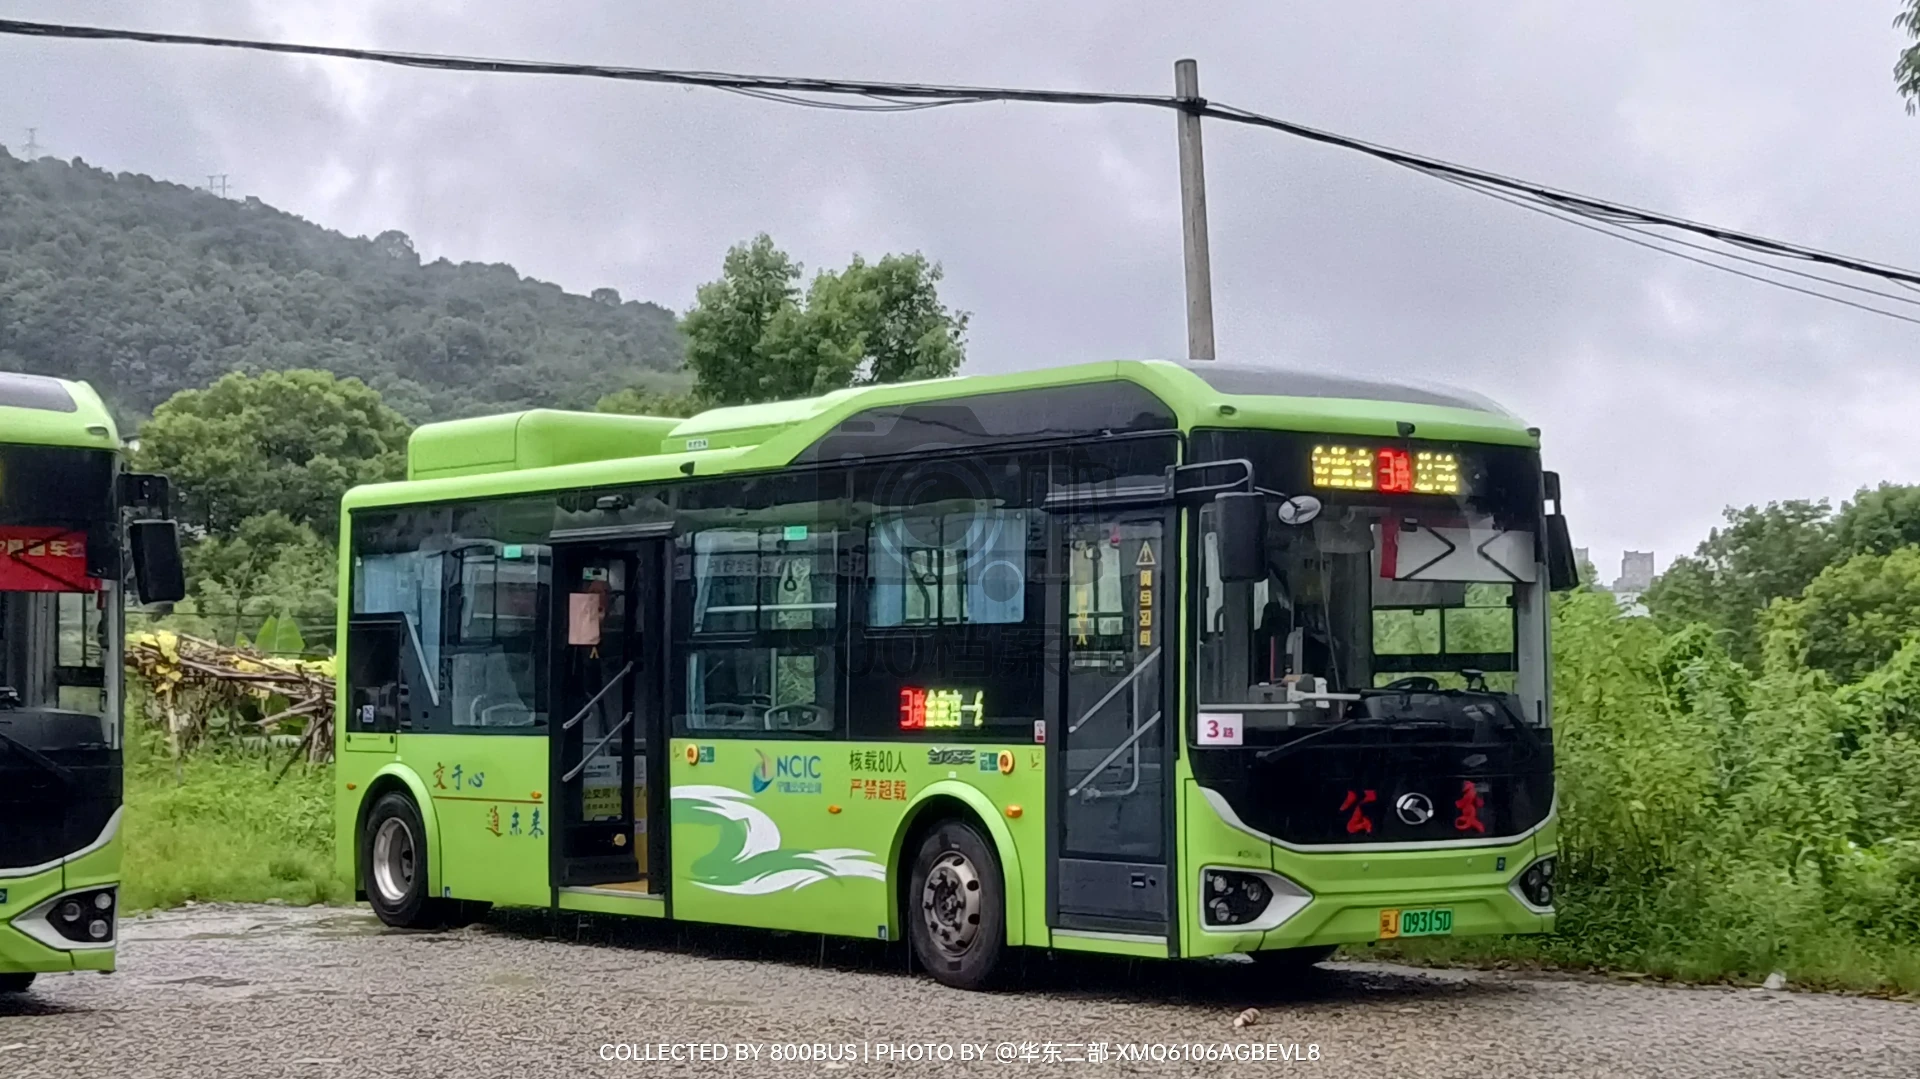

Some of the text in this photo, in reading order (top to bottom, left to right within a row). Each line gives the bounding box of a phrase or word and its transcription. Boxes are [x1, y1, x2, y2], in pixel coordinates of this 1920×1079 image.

[776, 755, 822, 778] NCIC
[849, 750, 907, 773] 核载80人
[849, 778, 907, 800] 严禁超载
